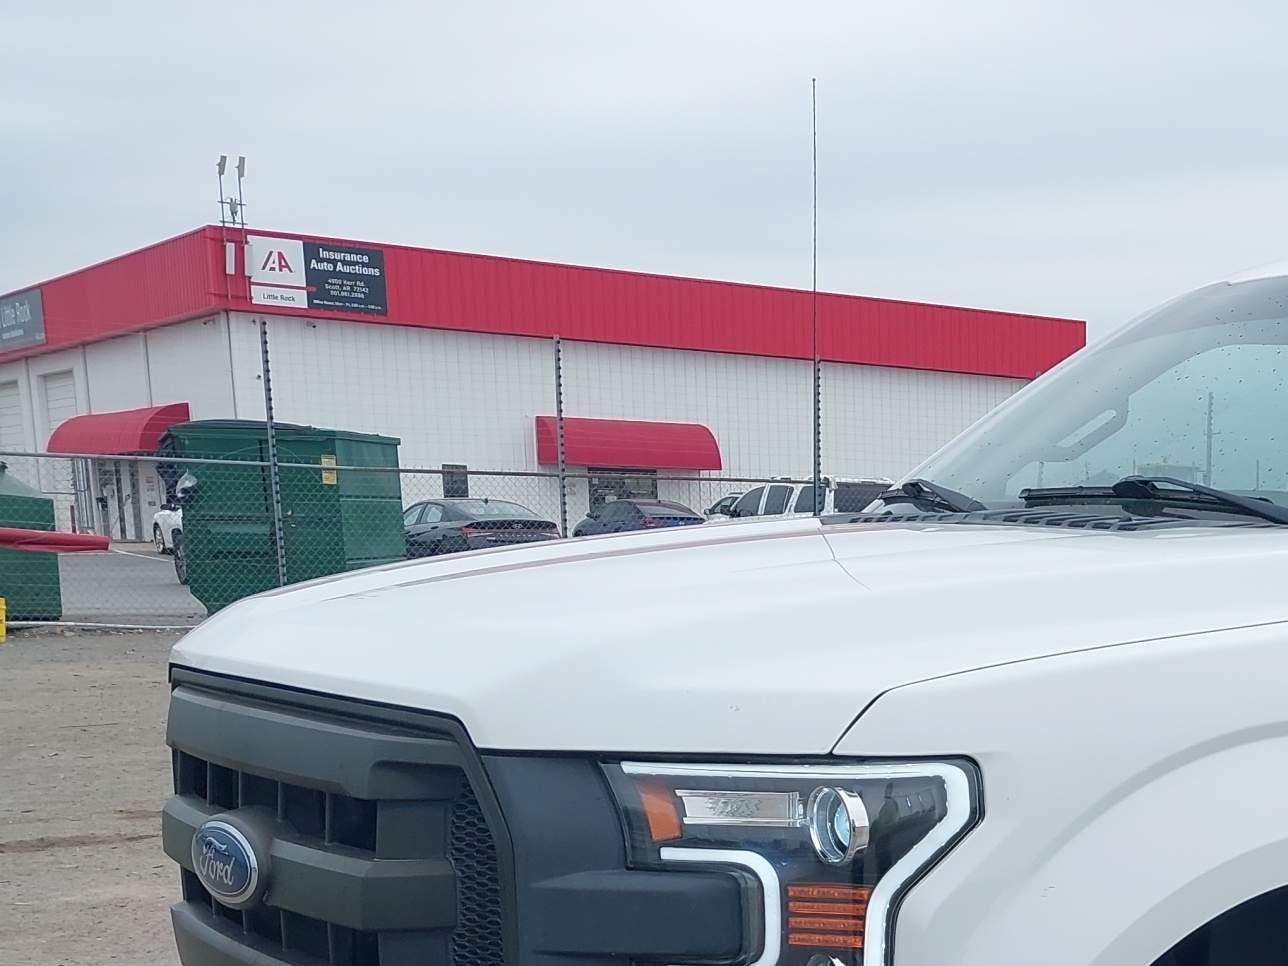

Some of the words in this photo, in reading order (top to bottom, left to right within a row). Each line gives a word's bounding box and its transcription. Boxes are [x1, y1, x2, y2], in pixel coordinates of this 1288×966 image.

[319, 248, 369, 263] Insurance
[310, 259, 334, 271] Auto
[335, 261, 381, 276] Auctions
[262, 292, 279, 301] Little
[280, 294, 296, 302] Rock
[199, 836, 236, 886] Ford
